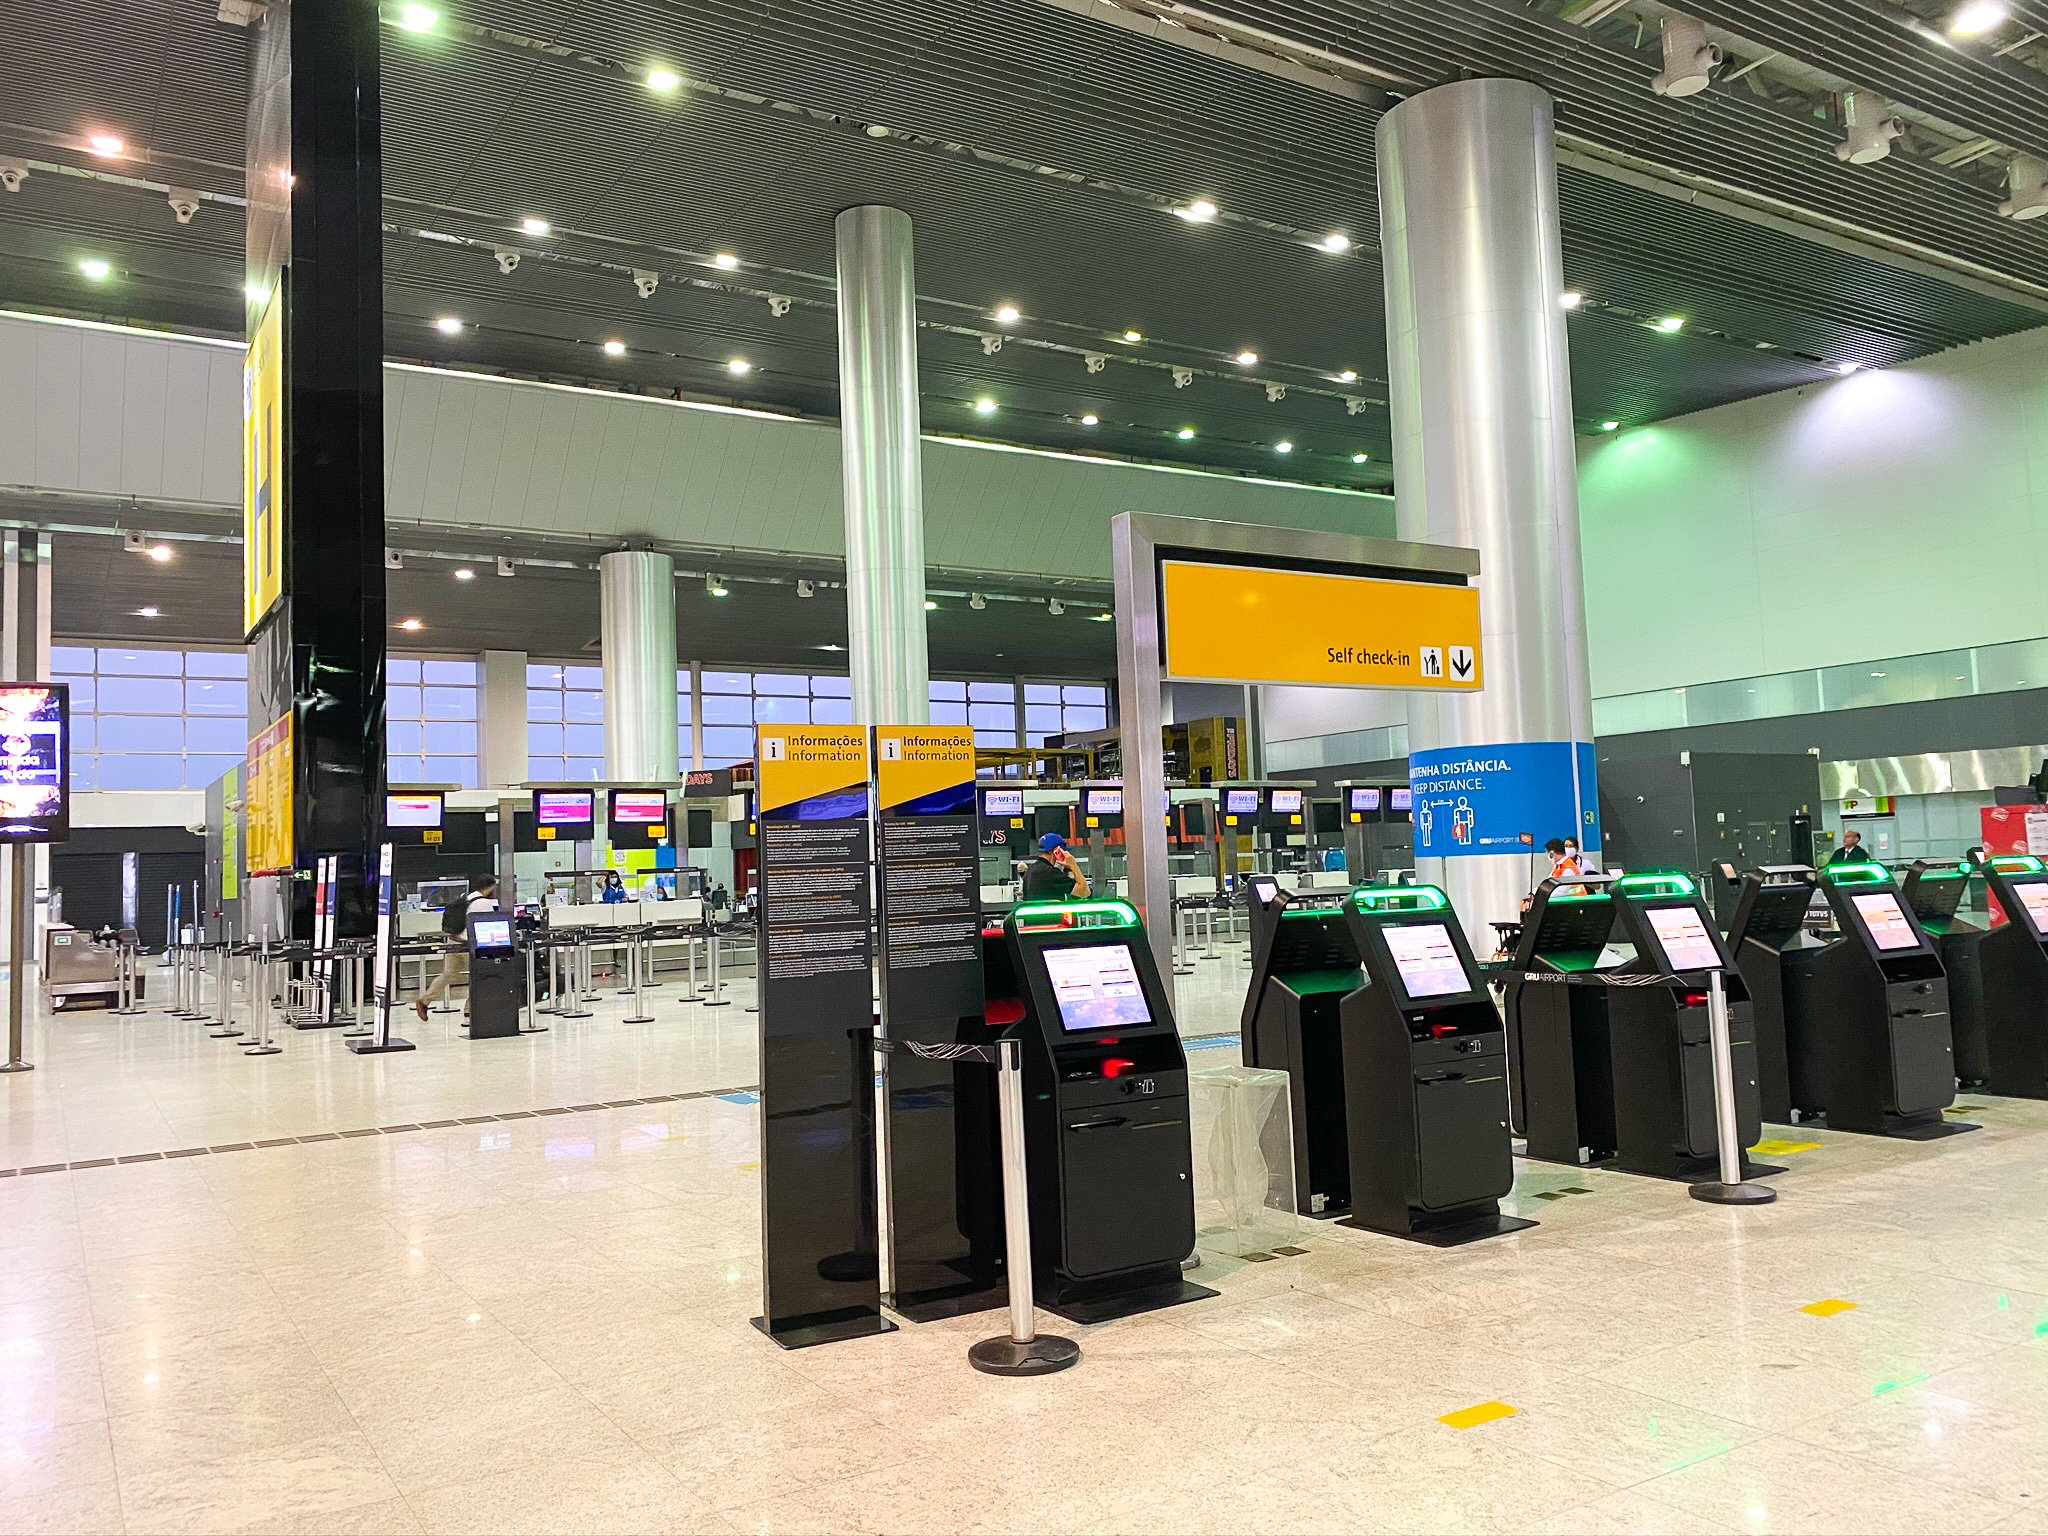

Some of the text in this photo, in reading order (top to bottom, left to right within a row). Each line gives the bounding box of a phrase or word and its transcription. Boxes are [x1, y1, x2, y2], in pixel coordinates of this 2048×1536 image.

[1327, 647, 1410, 666] Self check-in
[788, 735, 863, 749] Informações
[903, 735, 972, 749] Informações
[788, 750, 861, 761] Information
[903, 750, 970, 761] Information
[1442, 759, 1512, 774] DISTÂNCIA.
[1429, 778, 1486, 793] DISTANCE.
